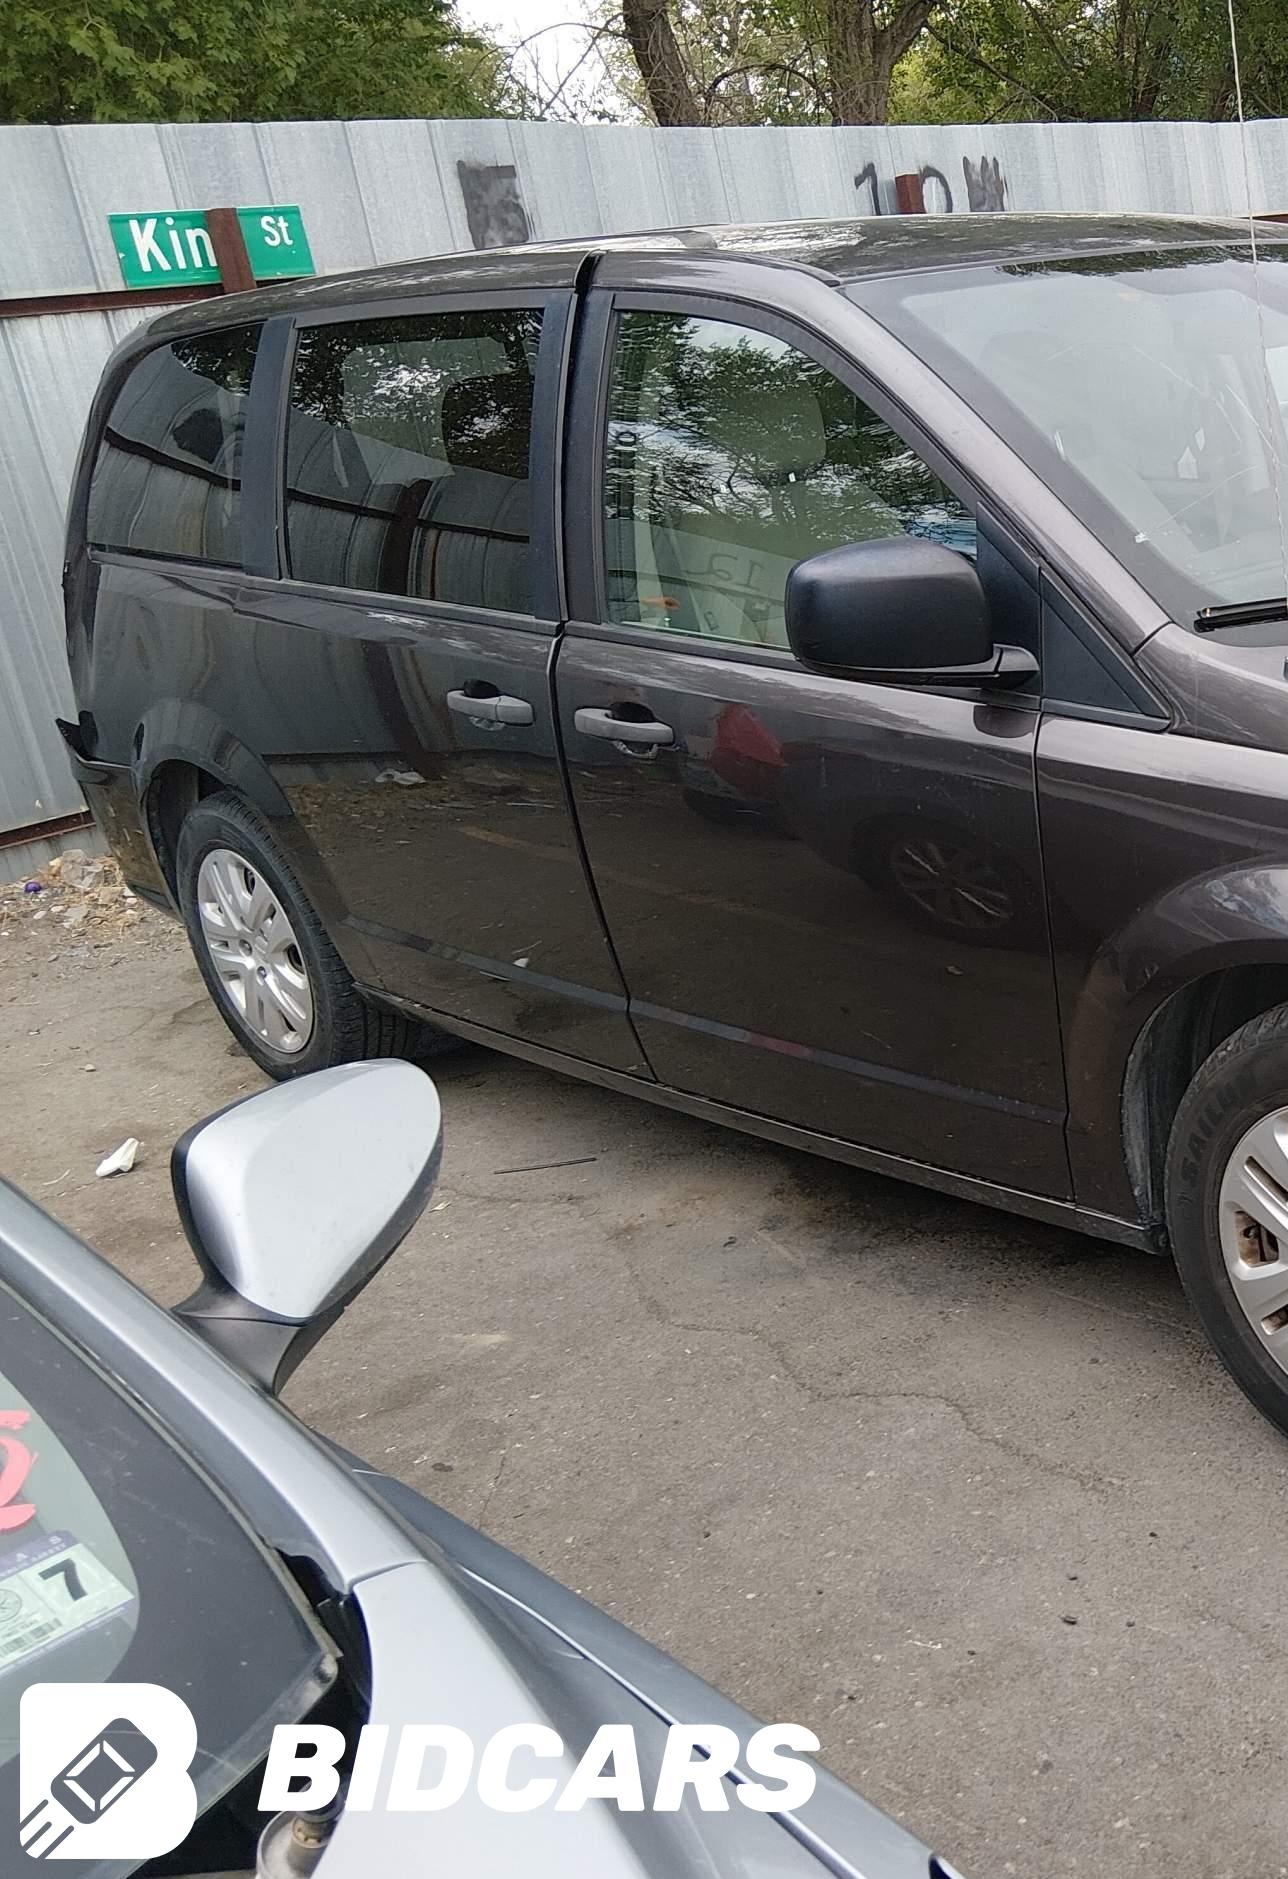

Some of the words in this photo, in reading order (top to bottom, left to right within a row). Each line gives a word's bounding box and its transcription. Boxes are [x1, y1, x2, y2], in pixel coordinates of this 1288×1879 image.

[128, 217, 218, 272] Kin
[261, 215, 293, 247] St
[38, 1558, 88, 1601] 7
